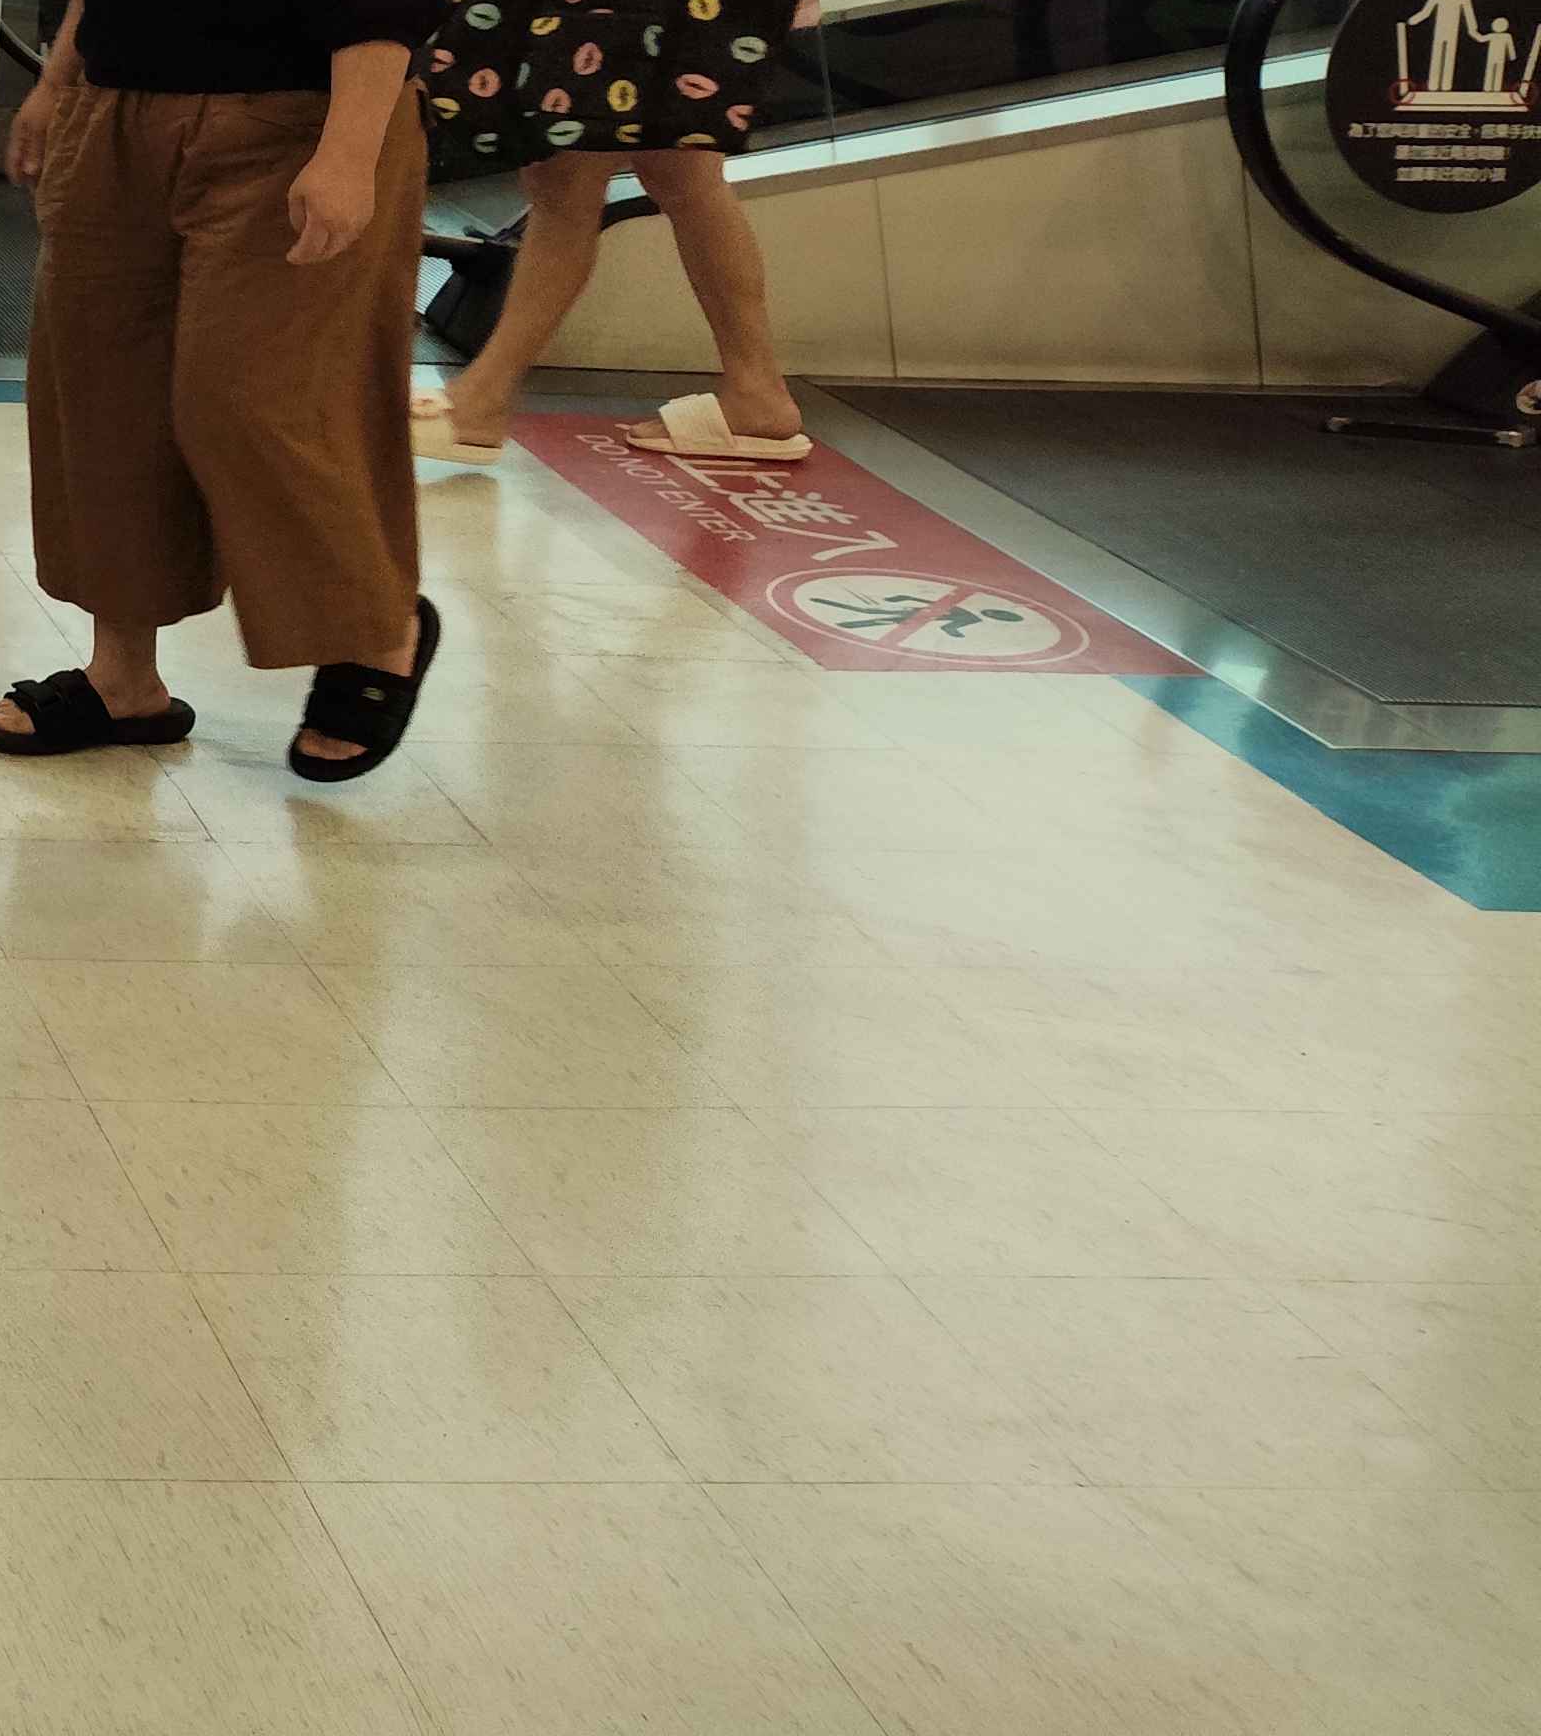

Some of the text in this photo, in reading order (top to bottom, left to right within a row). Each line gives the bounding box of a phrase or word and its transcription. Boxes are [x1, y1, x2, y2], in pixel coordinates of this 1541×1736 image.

[574, 432, 758, 544] DO NOT ENTER
